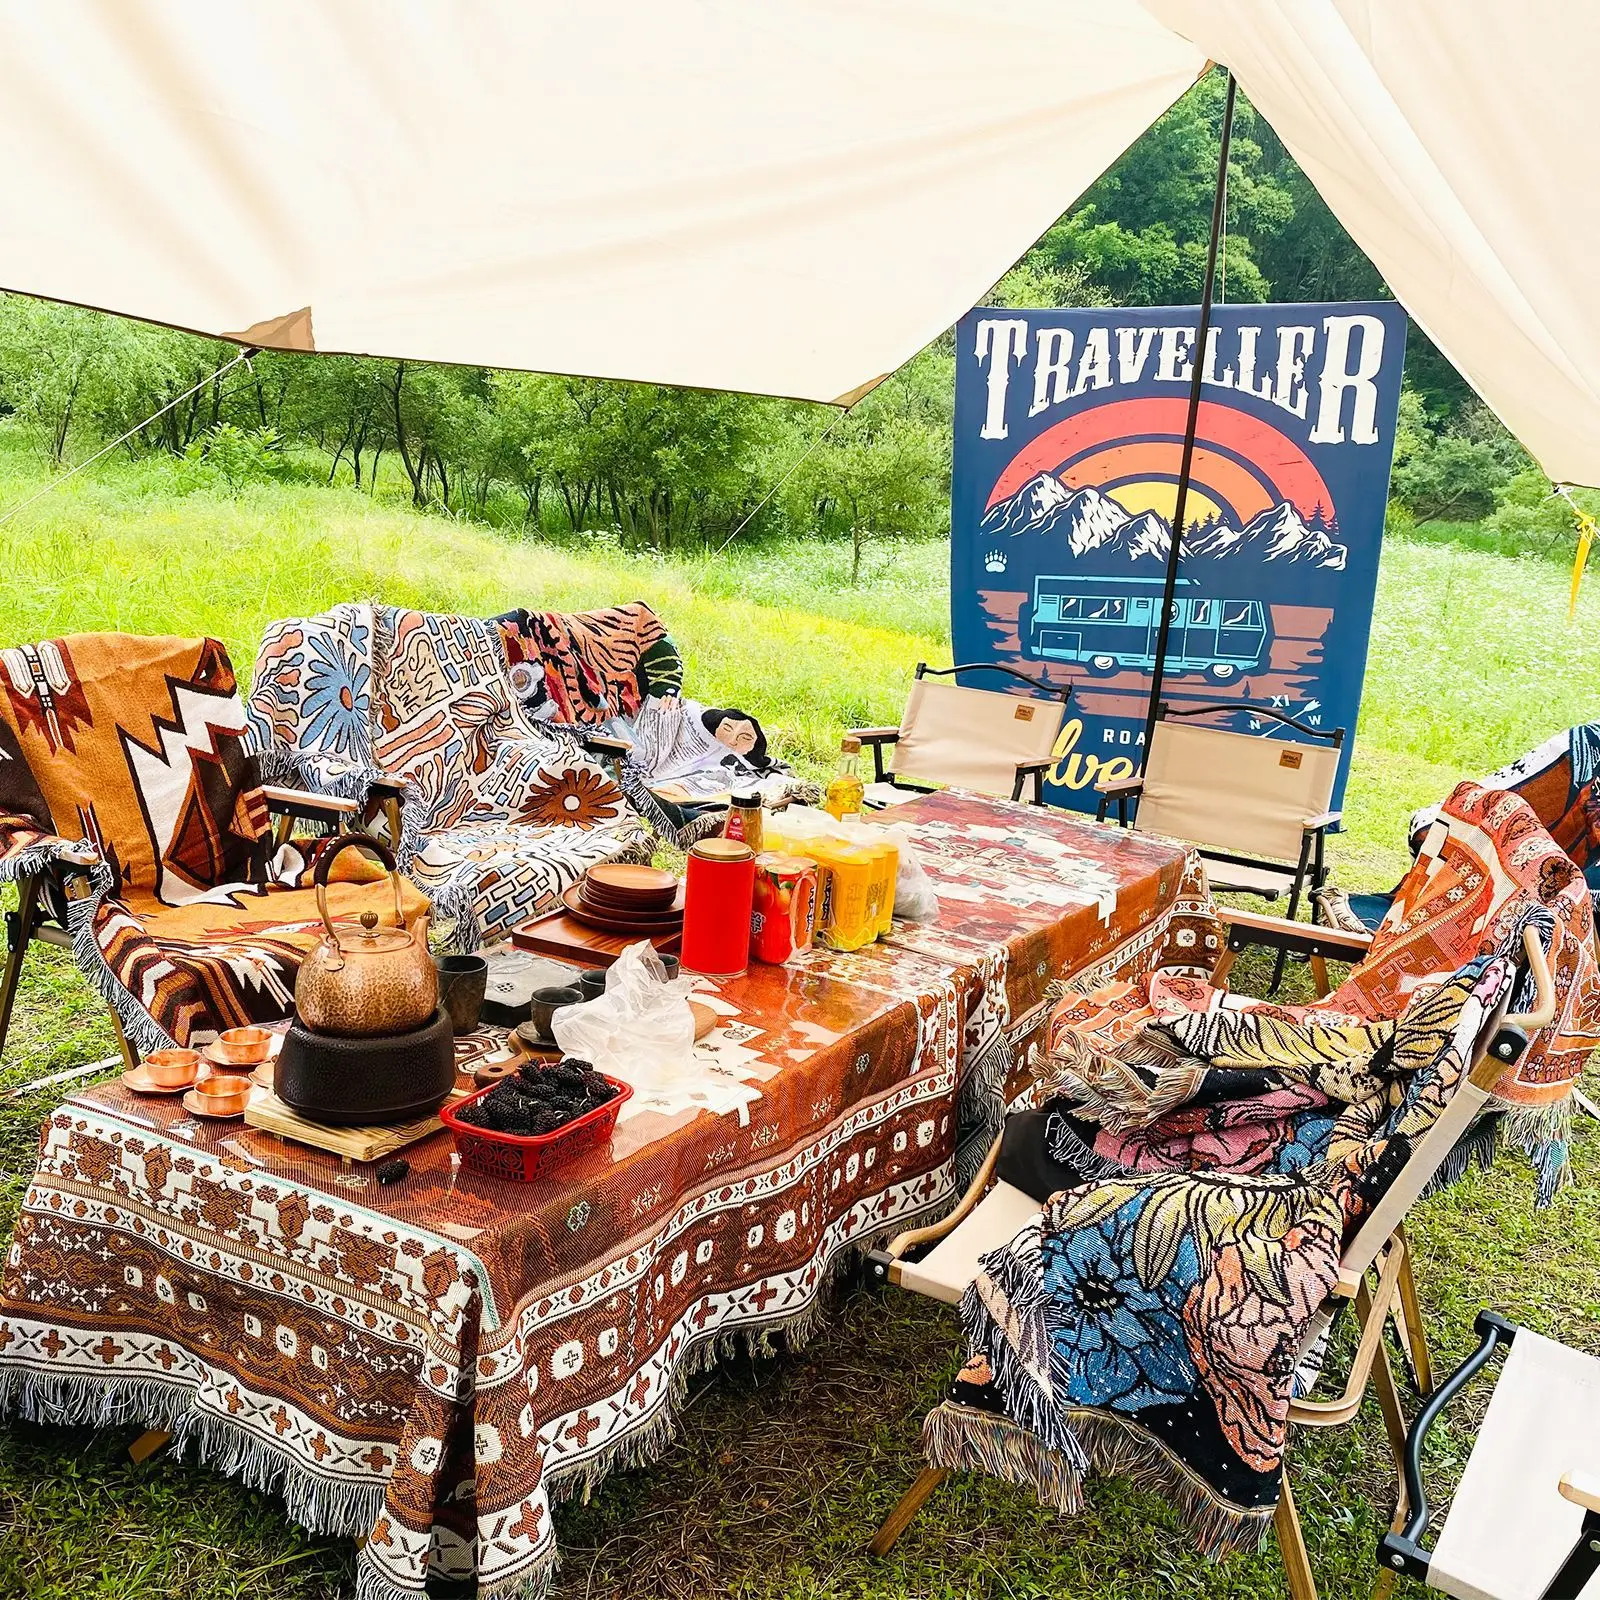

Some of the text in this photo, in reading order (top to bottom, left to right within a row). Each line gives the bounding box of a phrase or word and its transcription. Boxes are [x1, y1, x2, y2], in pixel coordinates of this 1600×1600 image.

[973, 315, 1386, 446] TRAVELLER
[1308, 714, 1322, 726] W
[1103, 728, 1146, 747] ROA
